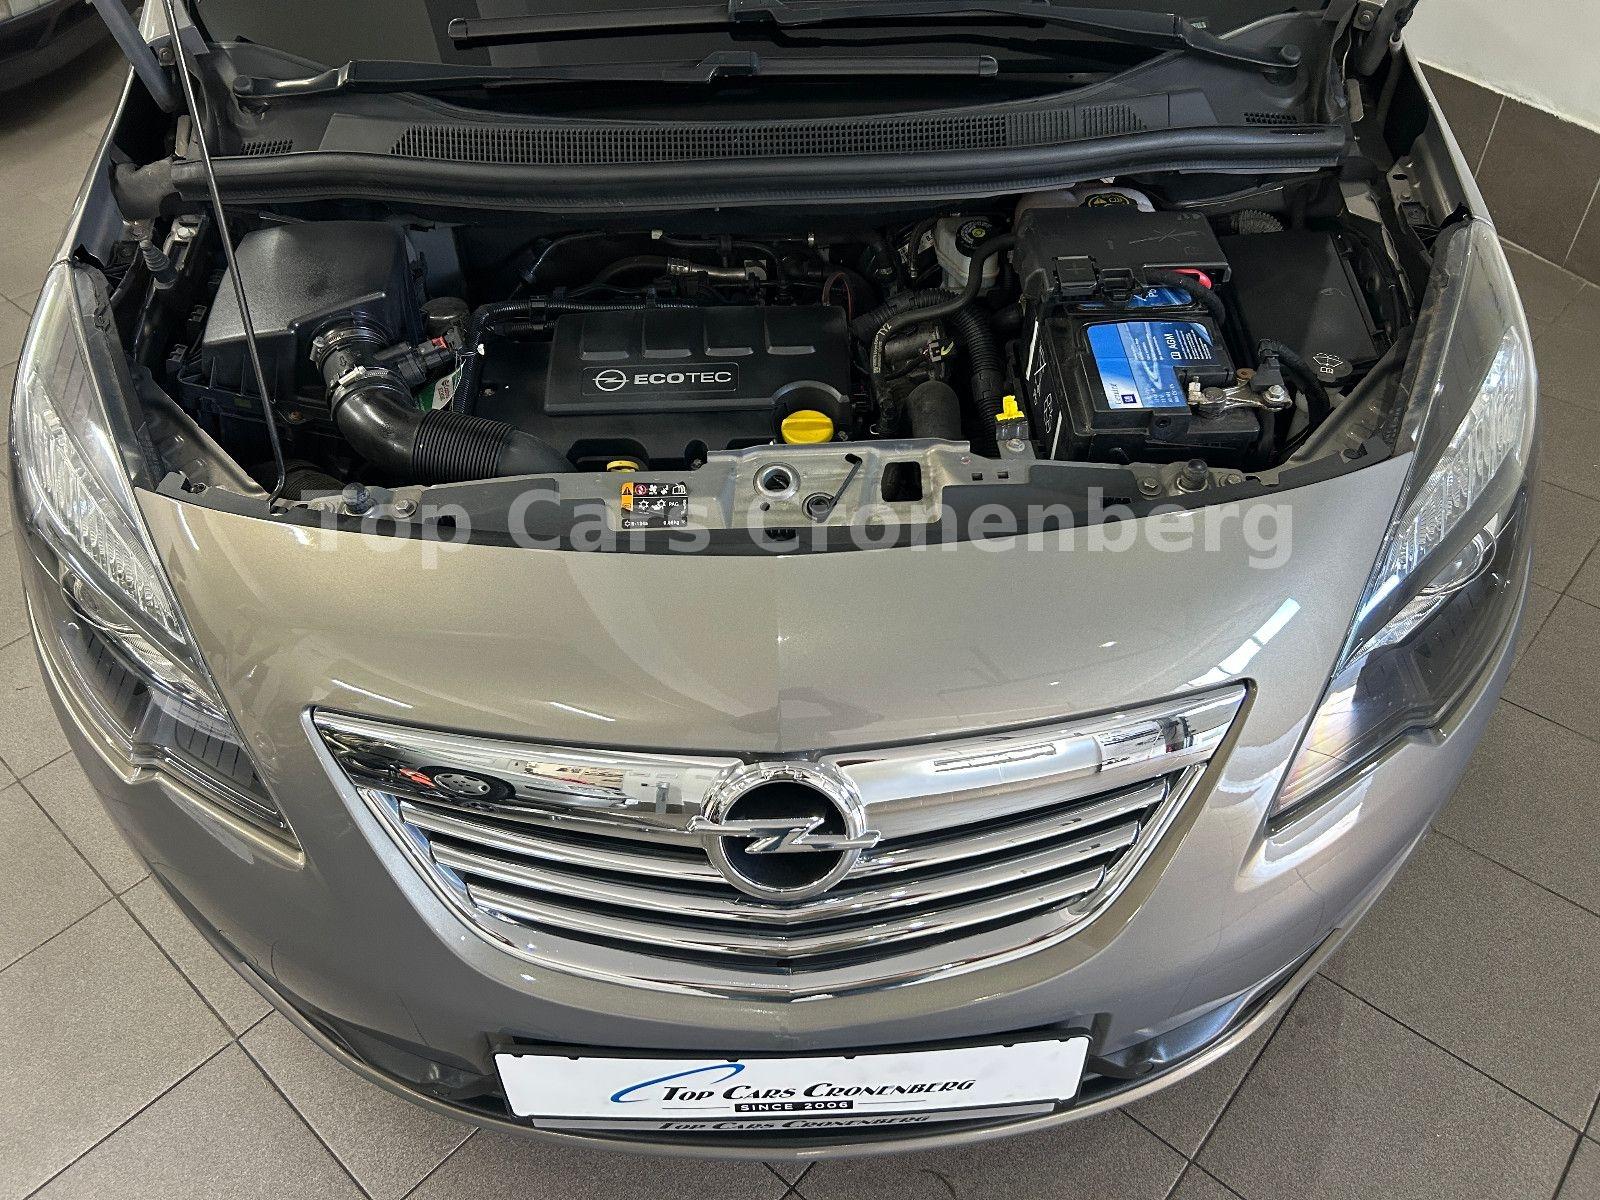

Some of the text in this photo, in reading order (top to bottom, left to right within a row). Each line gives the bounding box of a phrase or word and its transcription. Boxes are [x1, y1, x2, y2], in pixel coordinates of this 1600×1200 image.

[1164, 333, 1178, 350] AGM
[633, 371, 732, 385] ECOTEC
[740, 1101, 849, 1111] SINCE 2006
